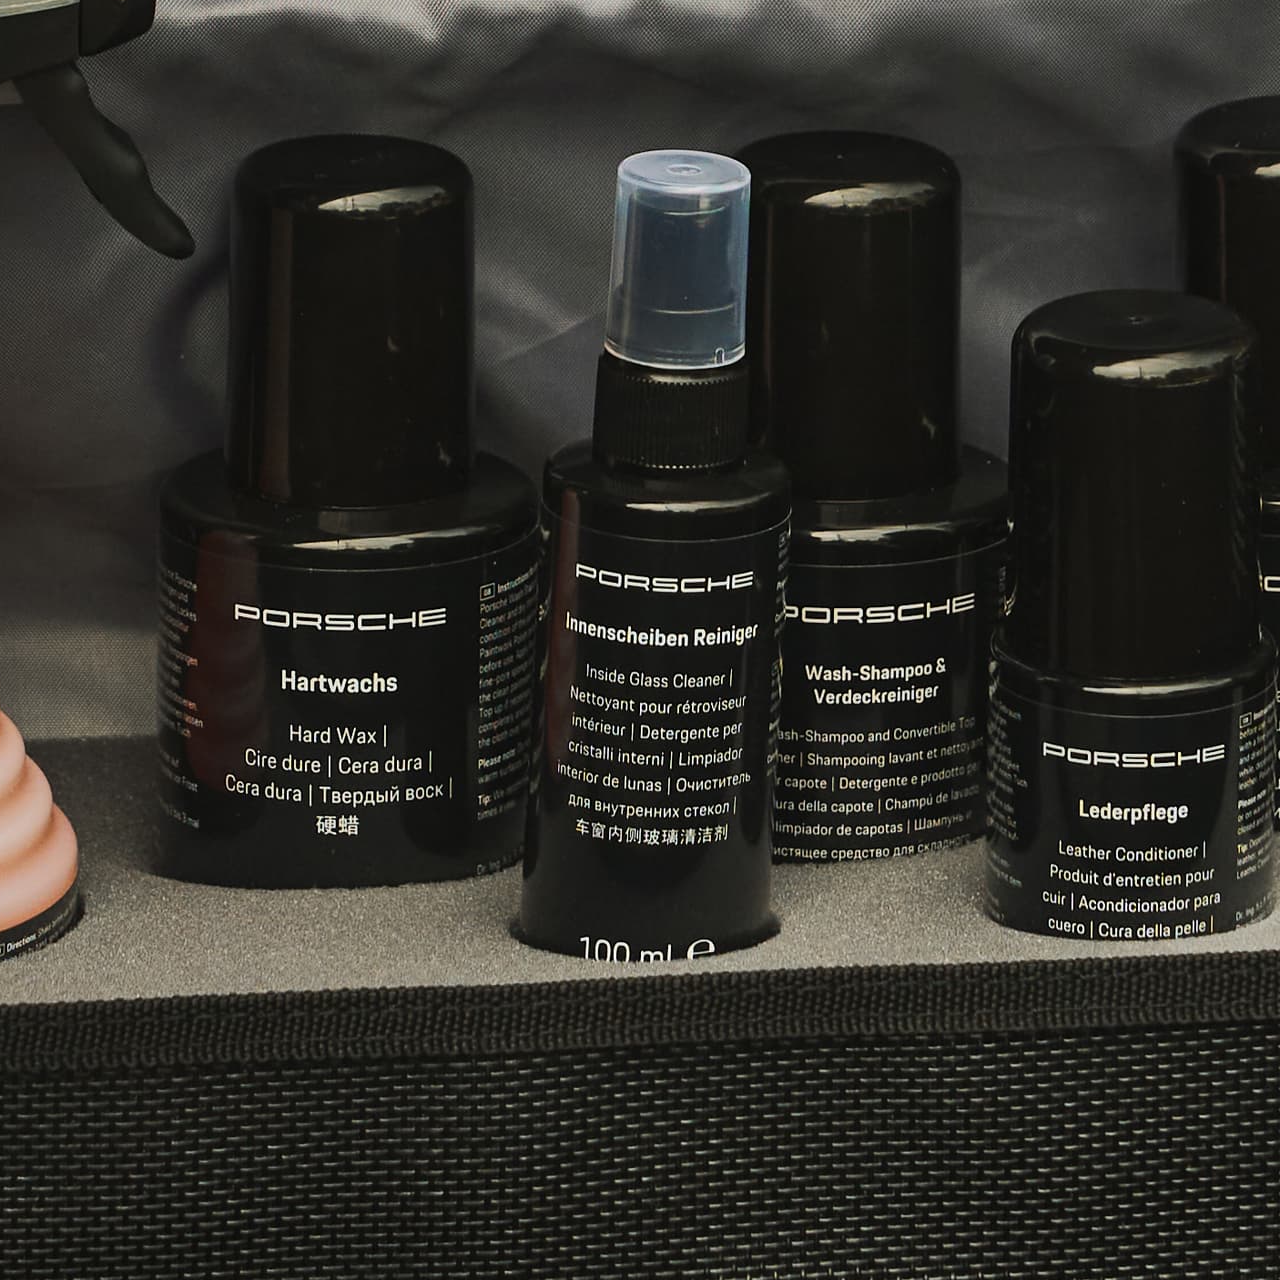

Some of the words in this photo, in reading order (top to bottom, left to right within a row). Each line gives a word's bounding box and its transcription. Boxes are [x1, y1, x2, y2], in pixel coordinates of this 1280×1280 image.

[575, 563, 754, 593] PORSCHE
[234, 603, 447, 632] PORSCHE
[566, 611, 689, 647] Innenscheiben
[693, 623, 759, 647] Reiniger
[281, 669, 398, 694] Hartwachs
[586, 663, 625, 685] Inside
[629, 671, 669, 689] Glass
[673, 671, 725, 689] Cleaner
[805, 660, 933, 682] Wash-Shampoo
[935, 657, 946, 674] &
[570, 685, 635, 712] Nettoyant
[639, 701, 672, 716] pour
[676, 695, 747, 715] rétroviseur
[814, 683, 939, 704] Verdeckreiniger
[289, 724, 332, 745] Hard
[336, 725, 377, 746] Wax
[571, 712, 626, 737] intérieur
[640, 724, 720, 743] Detergente
[723, 721, 742, 741] per
[777, 728, 865, 746] ash-Shampoo
[868, 727, 890, 743] and
[893, 718, 957, 741] Convertible
[244, 749, 278, 771] Cire
[281, 754, 321, 774] dure
[337, 756, 379, 776] Cera
[384, 753, 423, 774] dura
[568, 739, 614, 761] cristalli
[618, 749, 665, 767] interni
[678, 746, 743, 769] Limpiador
[807, 752, 886, 768] Shampooing
[888, 749, 924, 764] lavant
[927, 747, 938, 759] et
[1043, 742, 1225, 768] PORSCHE
[557, 760, 599, 785] interior
[603, 772, 619, 788] de
[624, 775, 662, 793] lunas
[676, 770, 751, 793] Очиститель
[784, 777, 828, 791] capote
[839, 776, 908, 792] Detergente
[911, 774, 918, 785] e
[921, 765, 966, 786] prodotto
[225, 774, 260, 798] Cera
[264, 779, 302, 803] dura
[319, 784, 400, 809] Твердый
[405, 781, 444, 801] воск
[798, 799, 828, 812] della
[831, 801, 874, 816] capote
[885, 793, 933, 812] Champú
[935, 791, 949, 804] de
[568, 792, 591, 809] для
[595, 799, 679, 820] внутренних
[684, 800, 730, 818] стекол
[1079, 799, 1189, 825] Lederpflege
[315, 814, 360, 837] 硬蜡
[575, 818, 729, 846] 车窗内侧玻璃清洁剂
[775, 820, 833, 838] limpiador
[836, 823, 852, 837] de
[855, 822, 904, 837] capotas
[773, 847, 828, 860] истящее
[831, 845, 890, 862] средство
[893, 844, 914, 858] для
[1058, 839, 1112, 861] Leather
[1115, 842, 1198, 862] Conditioner
[1049, 863, 1099, 887] Produit
[1103, 872, 1182, 888] d'entretien
[1185, 867, 1216, 888] pour
[1042, 890, 1066, 906] cuir
[1079, 894, 1190, 913] Acondicionador
[1193, 891, 1221, 911] para
[1048, 917, 1086, 935] cuero
[1098, 922, 1132, 938] Cura
[1136, 922, 1171, 938] della
[1175, 919, 1207, 939] pelle
[580, 936, 631, 963] 100
[640, 943, 672, 963] ml
